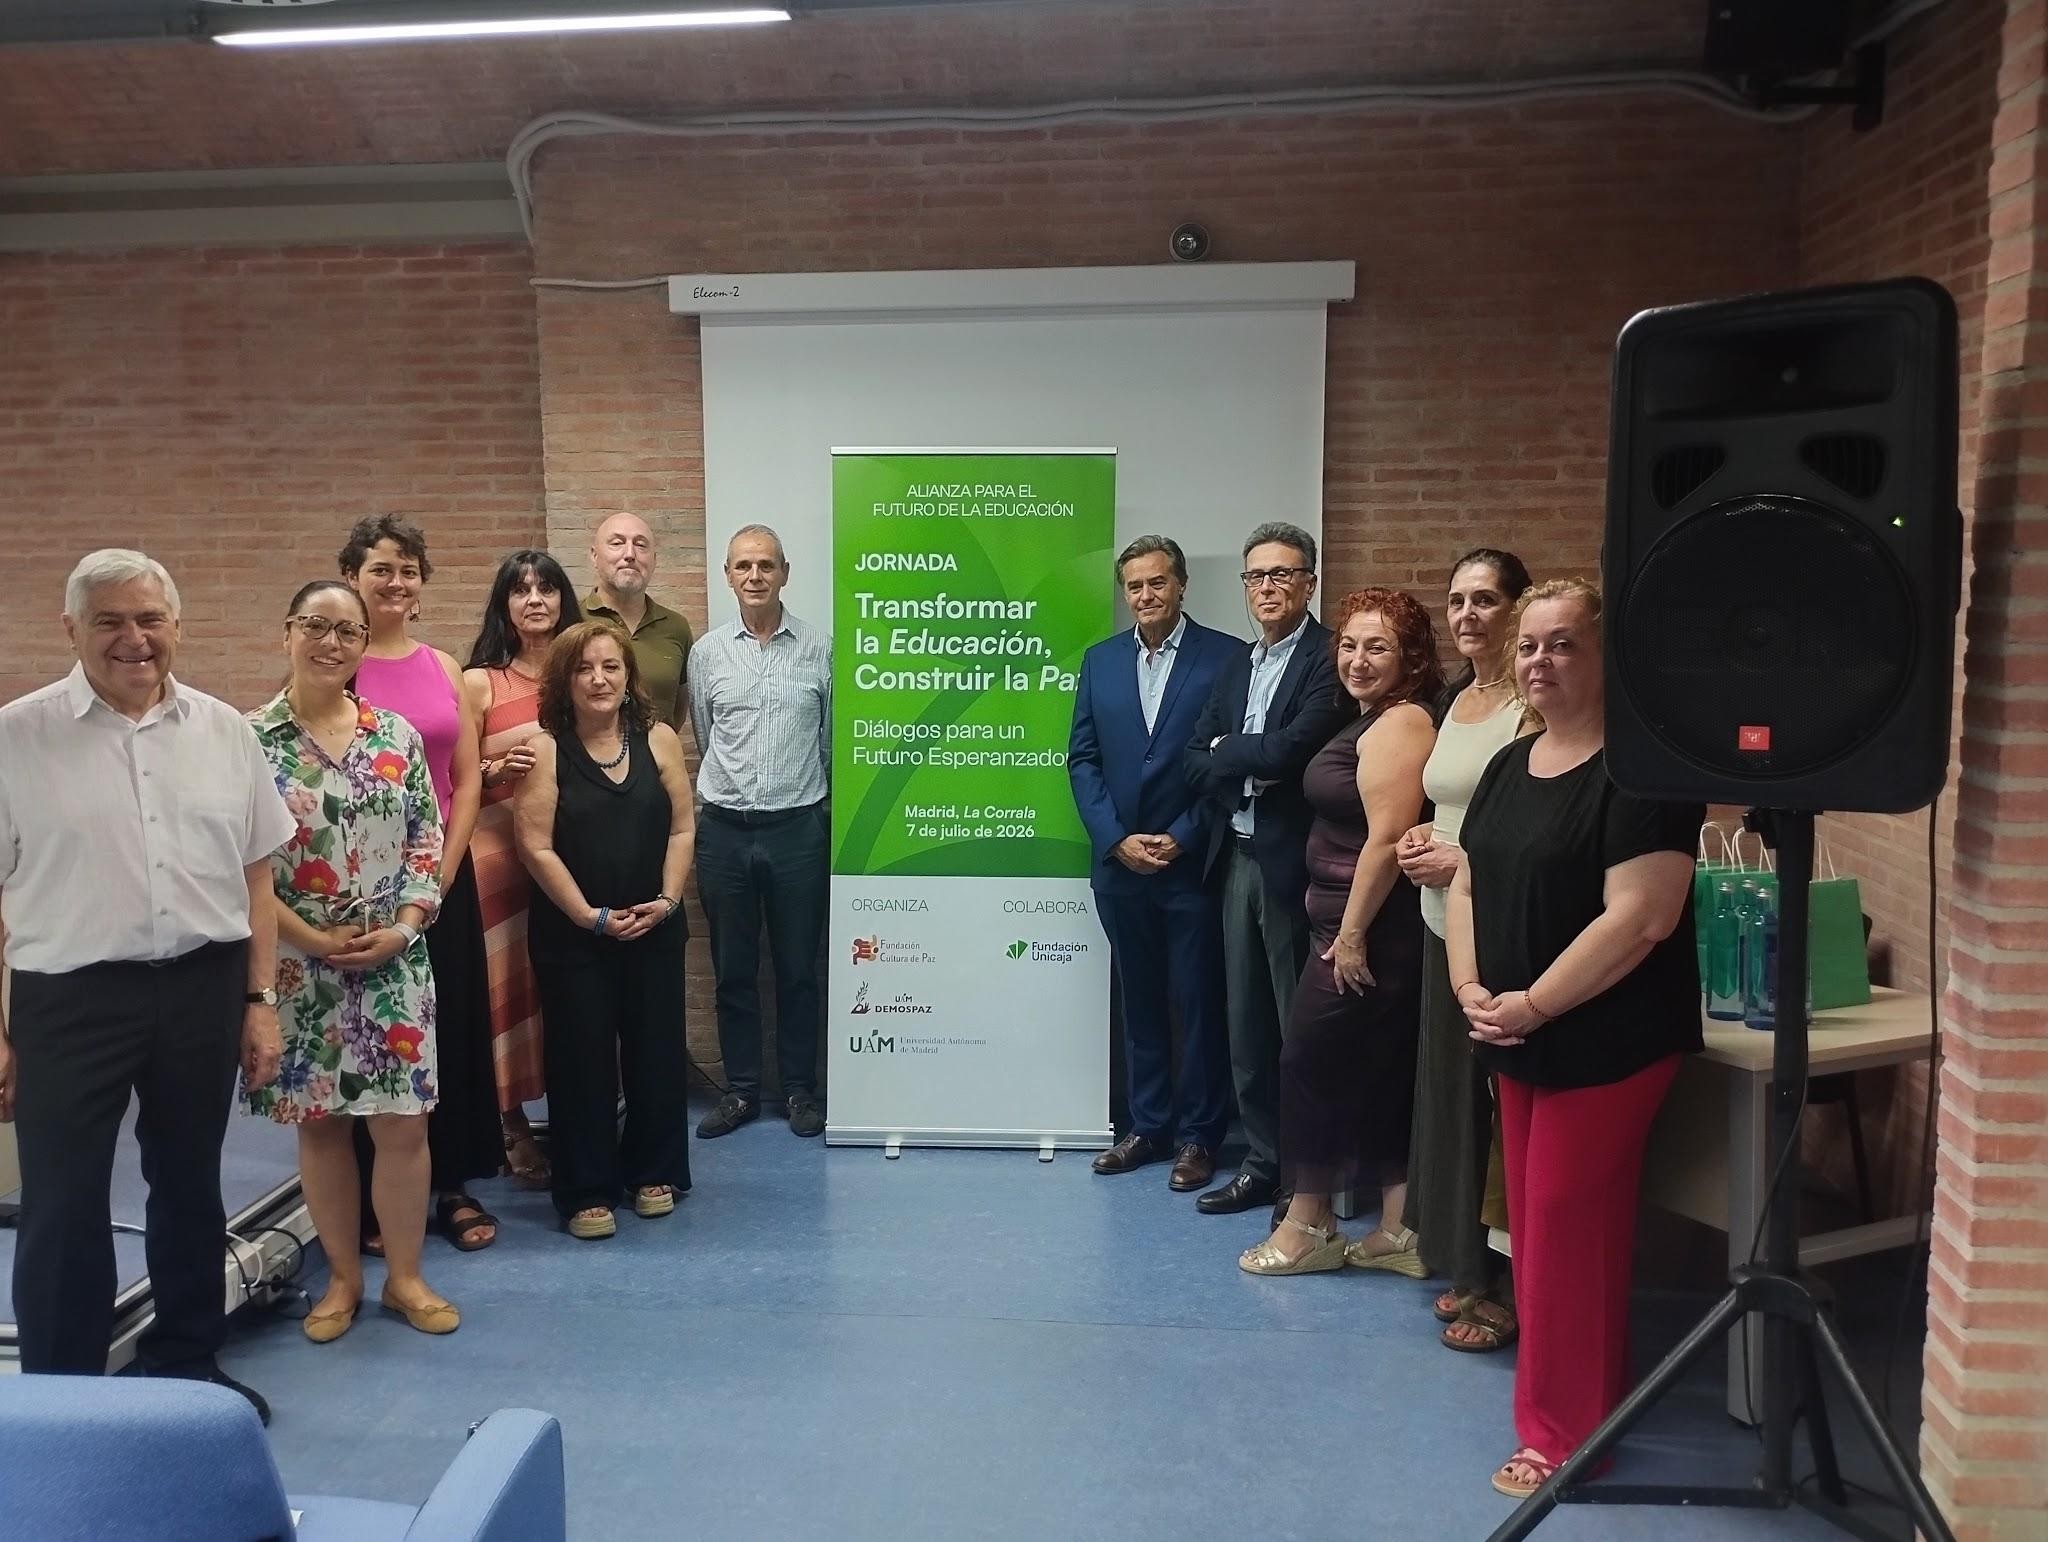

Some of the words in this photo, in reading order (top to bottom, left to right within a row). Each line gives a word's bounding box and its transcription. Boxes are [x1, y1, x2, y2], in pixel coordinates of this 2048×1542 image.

[906, 484, 971, 498] ALIANZA
[975, 485, 1015, 498] PARA
[1019, 485, 1037, 498] EL
[873, 503, 935, 517] FUTURO
[938, 504, 958, 517] DE
[961, 504, 981, 517] LA
[984, 500, 1074, 517] EDUCACIÓN
[855, 553, 958, 572] JORNADA
[854, 592, 1037, 620] Transformar
[855, 628, 879, 655] la
[889, 628, 1052, 659] Educación,
[854, 663, 995, 691] Construir
[1004, 665, 1029, 691] la
[1038, 665, 1081, 692] Pa
[853, 719, 941, 742] Diálogos
[946, 724, 994, 743] para
[999, 724, 1025, 740] un
[853, 747, 924, 766] Futuro
[904, 804, 960, 820] Madrid,
[963, 805, 980, 819] La
[984, 805, 1036, 820] Corrala
[906, 824, 916, 837] 7
[919, 824, 938, 838] de
[940, 824, 971, 840] julio
[974, 825, 993, 838] de
[996, 825, 1035, 838] 2026
[851, 898, 929, 912] ORGANIZA
[1003, 900, 1088, 914] COLABORA
[880, 939, 920, 950] Fundación
[1031, 941, 1088, 953] Fundación
[880, 952, 909, 963] Cultura
[910, 954, 920, 963] de
[922, 952, 936, 963] Paz
[1031, 952, 1072, 965] Unicaja
[875, 1005, 933, 1014] DEMOSPAZ
[900, 1036, 946, 1045] Universidad
[900, 1046, 909, 1054] de
[911, 1046, 938, 1054] Madrid
